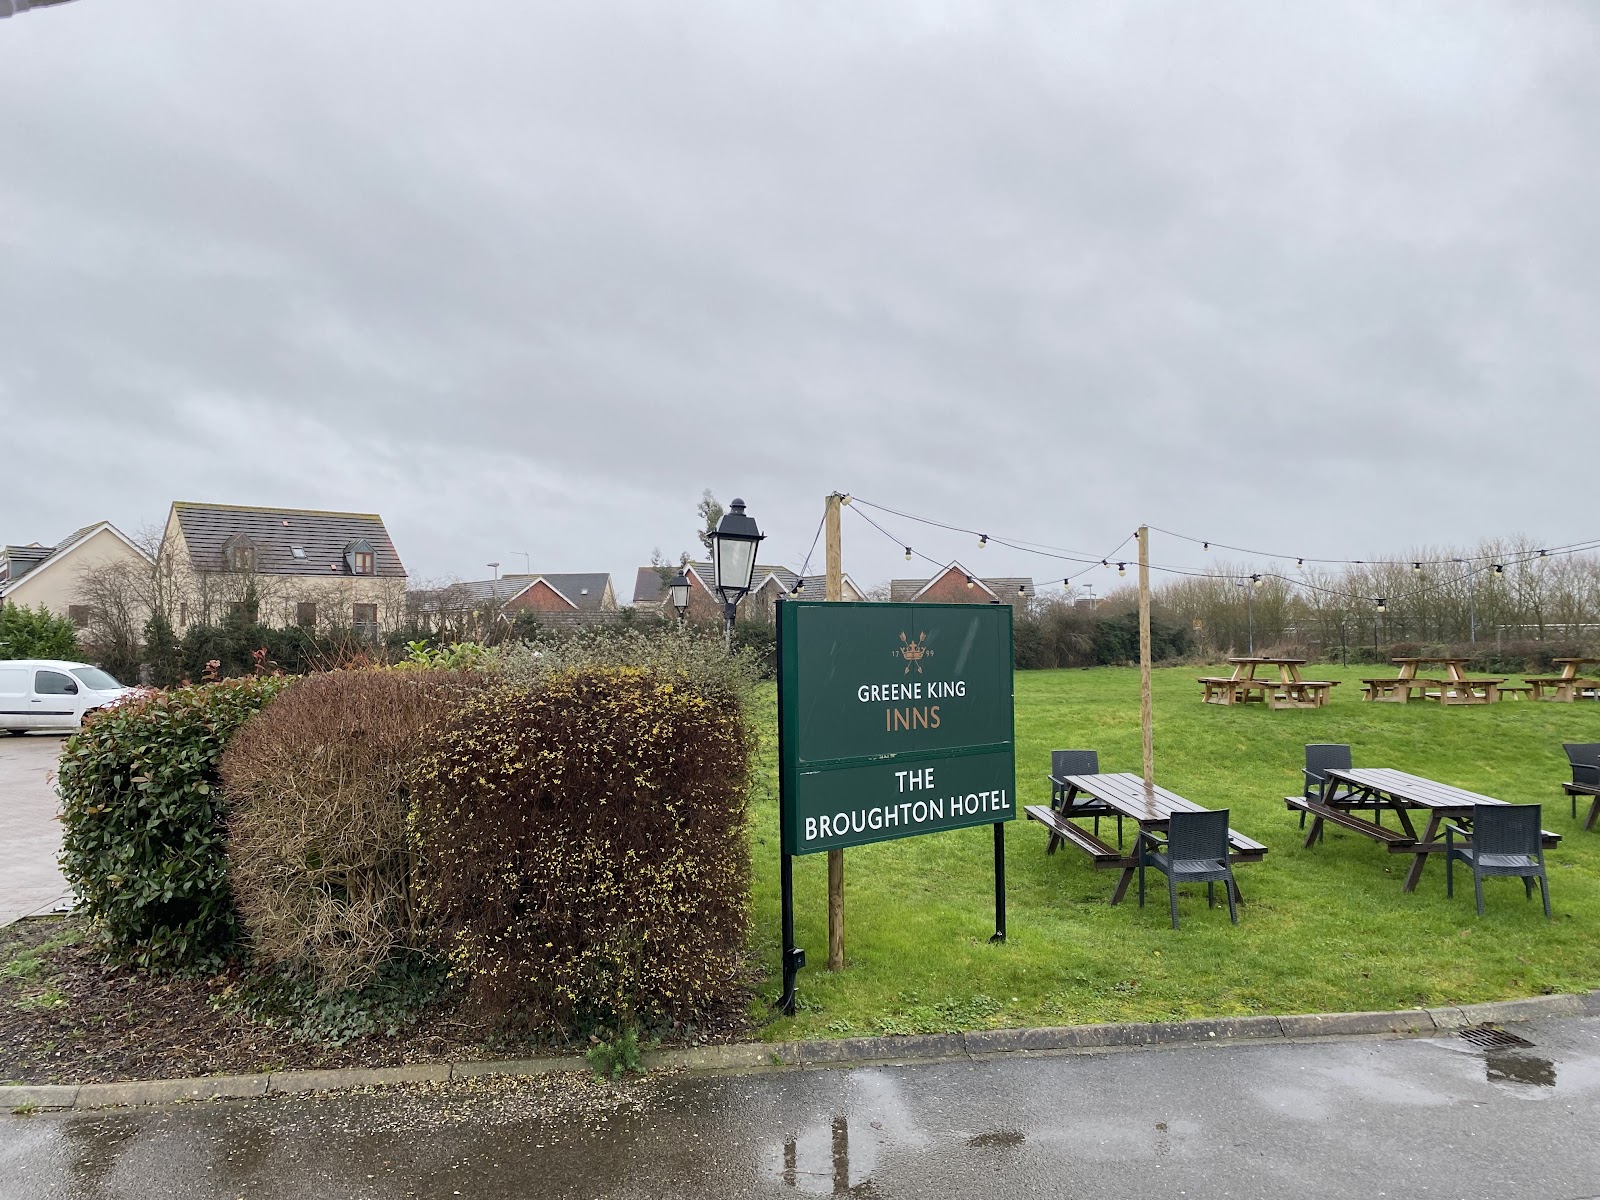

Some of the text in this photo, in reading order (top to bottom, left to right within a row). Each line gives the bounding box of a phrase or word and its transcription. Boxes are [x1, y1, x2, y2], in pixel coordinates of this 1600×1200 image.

[857, 681, 966, 702] GREENE KING
[886, 706, 941, 731] INNS
[895, 767, 935, 793] THE
[805, 790, 1010, 840] BROUGHTON HOTEL
